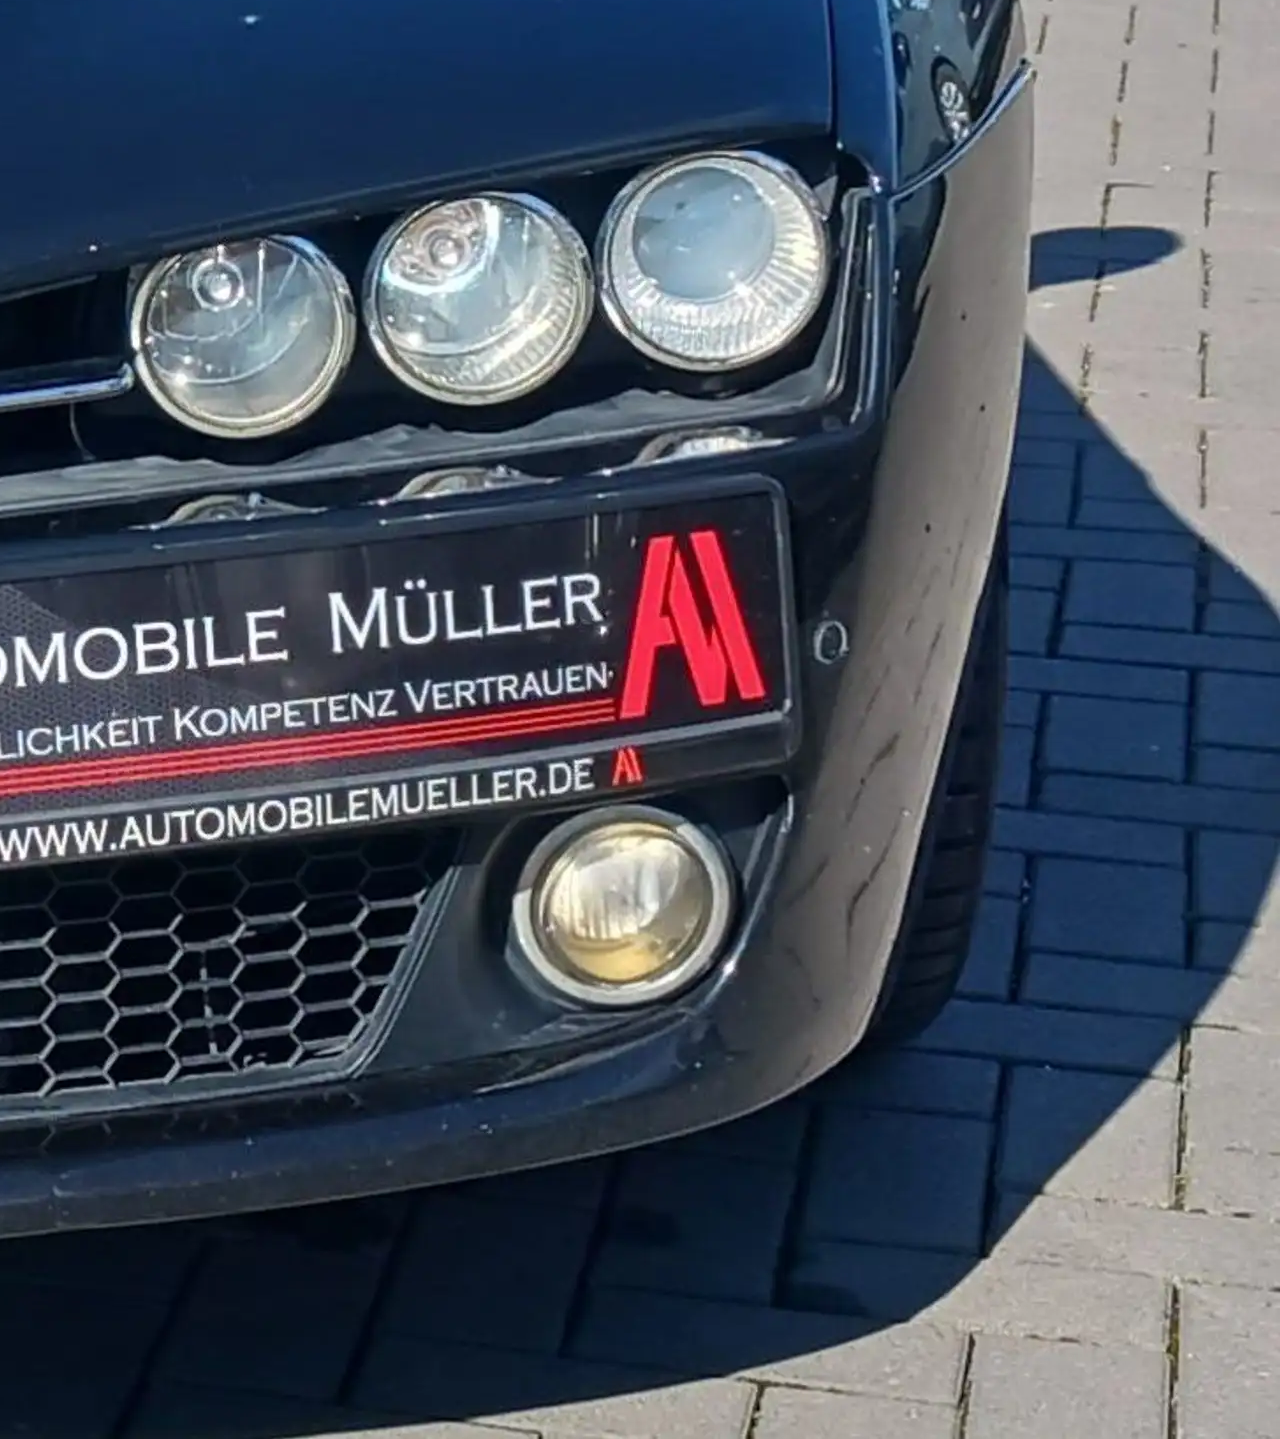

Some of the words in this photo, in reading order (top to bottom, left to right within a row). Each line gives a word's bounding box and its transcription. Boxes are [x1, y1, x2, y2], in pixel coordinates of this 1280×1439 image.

[327, 572, 603, 654] MÜLLER
[173, 688, 398, 741] KOMPETENZ
[403, 661, 609, 713] VERTRAUEN
